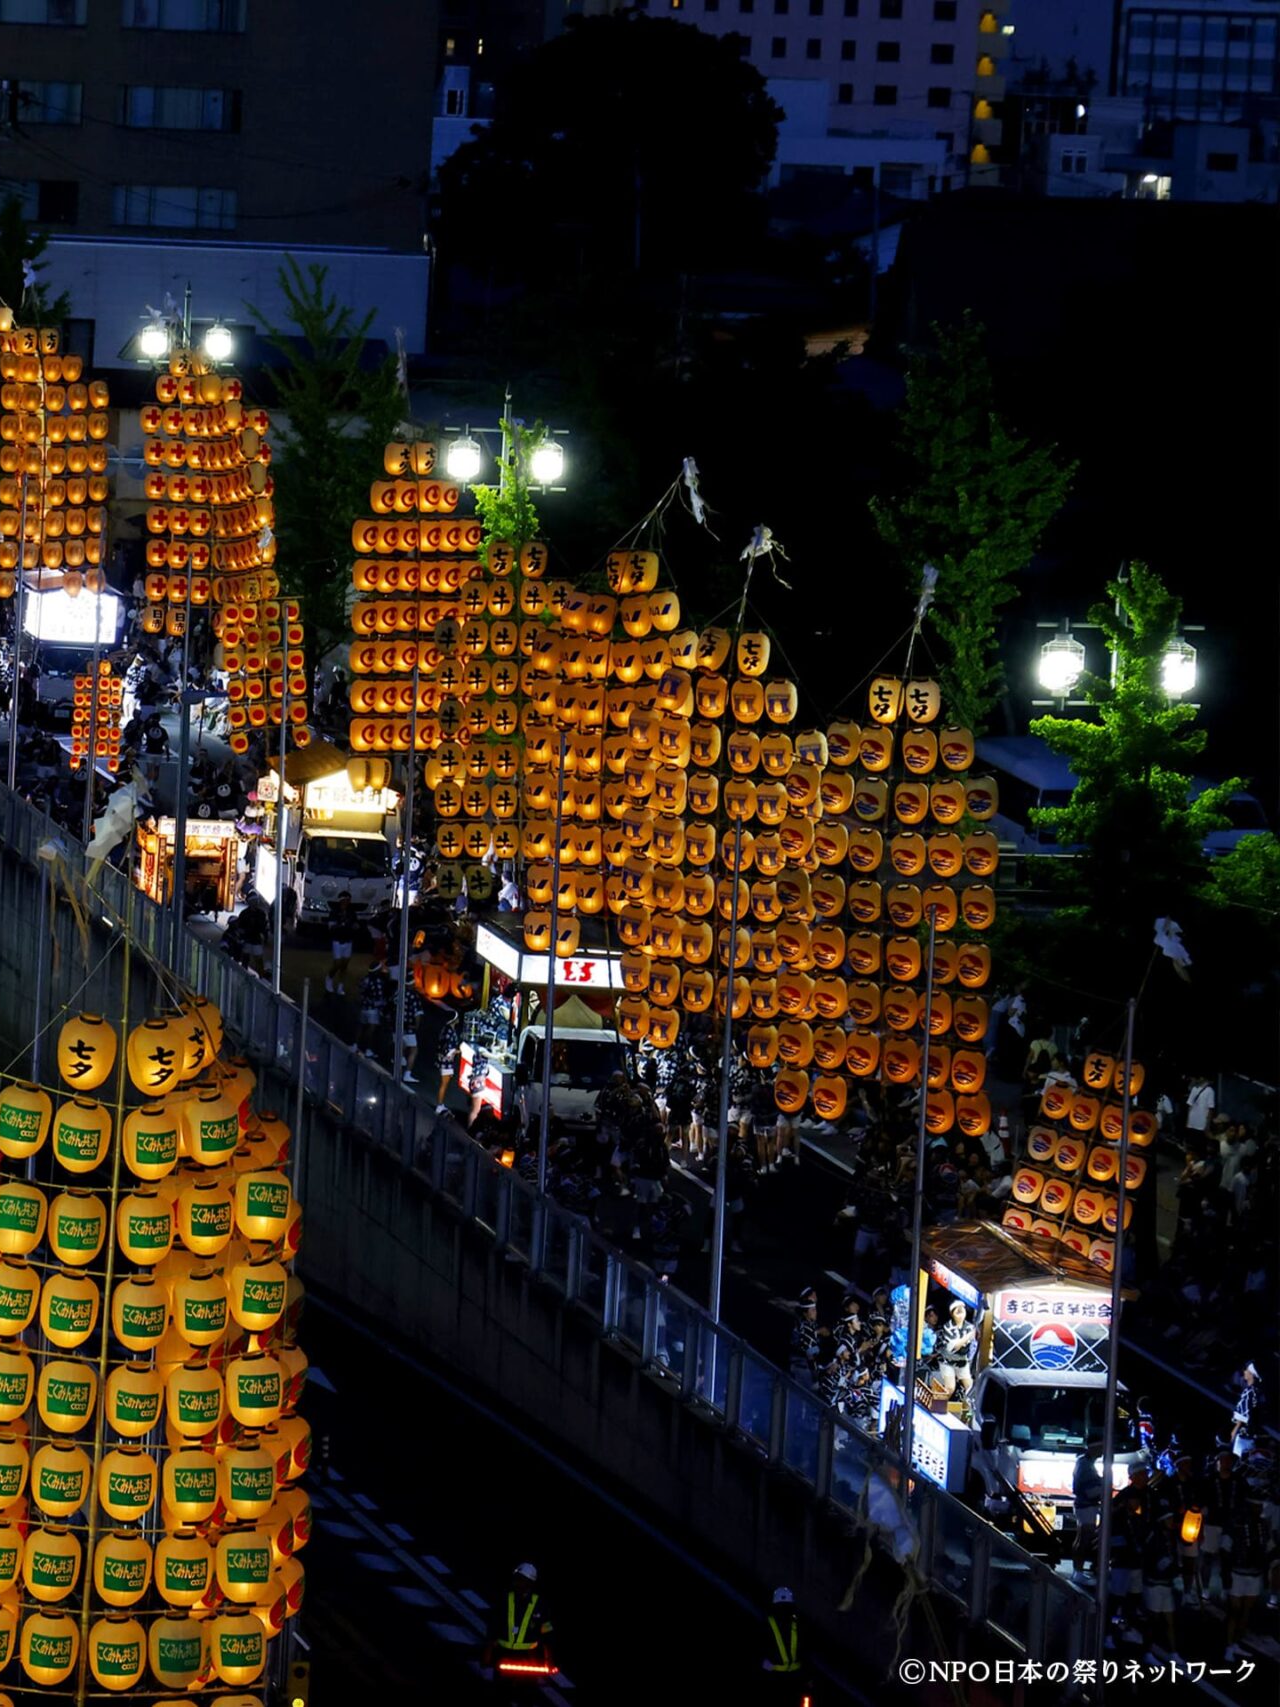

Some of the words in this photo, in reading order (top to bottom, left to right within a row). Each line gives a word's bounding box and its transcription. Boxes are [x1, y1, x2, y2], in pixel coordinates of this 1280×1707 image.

[493, 549, 508, 572] 七夕
[528, 548, 543, 572] 七夕
[630, 555, 646, 586] 七夕
[465, 588, 483, 610] 牛
[494, 586, 512, 609] 牛
[527, 586, 543, 608] 牛
[439, 626, 456, 649] 牛
[466, 627, 484, 650] 牛
[496, 627, 511, 650] 牛
[743, 640, 760, 670] 七夕
[441, 667, 458, 689] 牛
[469, 666, 485, 688] 牛
[497, 668, 513, 689] 牛
[873, 686, 892, 717] 七夕
[910, 689, 929, 718] 七夕
[441, 706, 459, 728] 牛
[470, 709, 487, 730] 牛
[497, 708, 513, 729] 牛
[441, 749, 457, 771] 牛
[471, 750, 488, 772] 牛
[498, 750, 514, 771] 牛
[439, 790, 457, 811] 牛
[469, 791, 485, 812] 牛
[496, 790, 513, 812] 牛
[442, 831, 459, 853] 牛
[469, 830, 486, 852] 牛
[496, 831, 513, 852] 牛
[442, 870, 458, 891] 牛
[471, 871, 487, 892] 牛
[68, 1040, 96, 1078] 七夕
[148, 1047, 175, 1086] 七夕
[1088, 1058, 1107, 1082] 七夕
